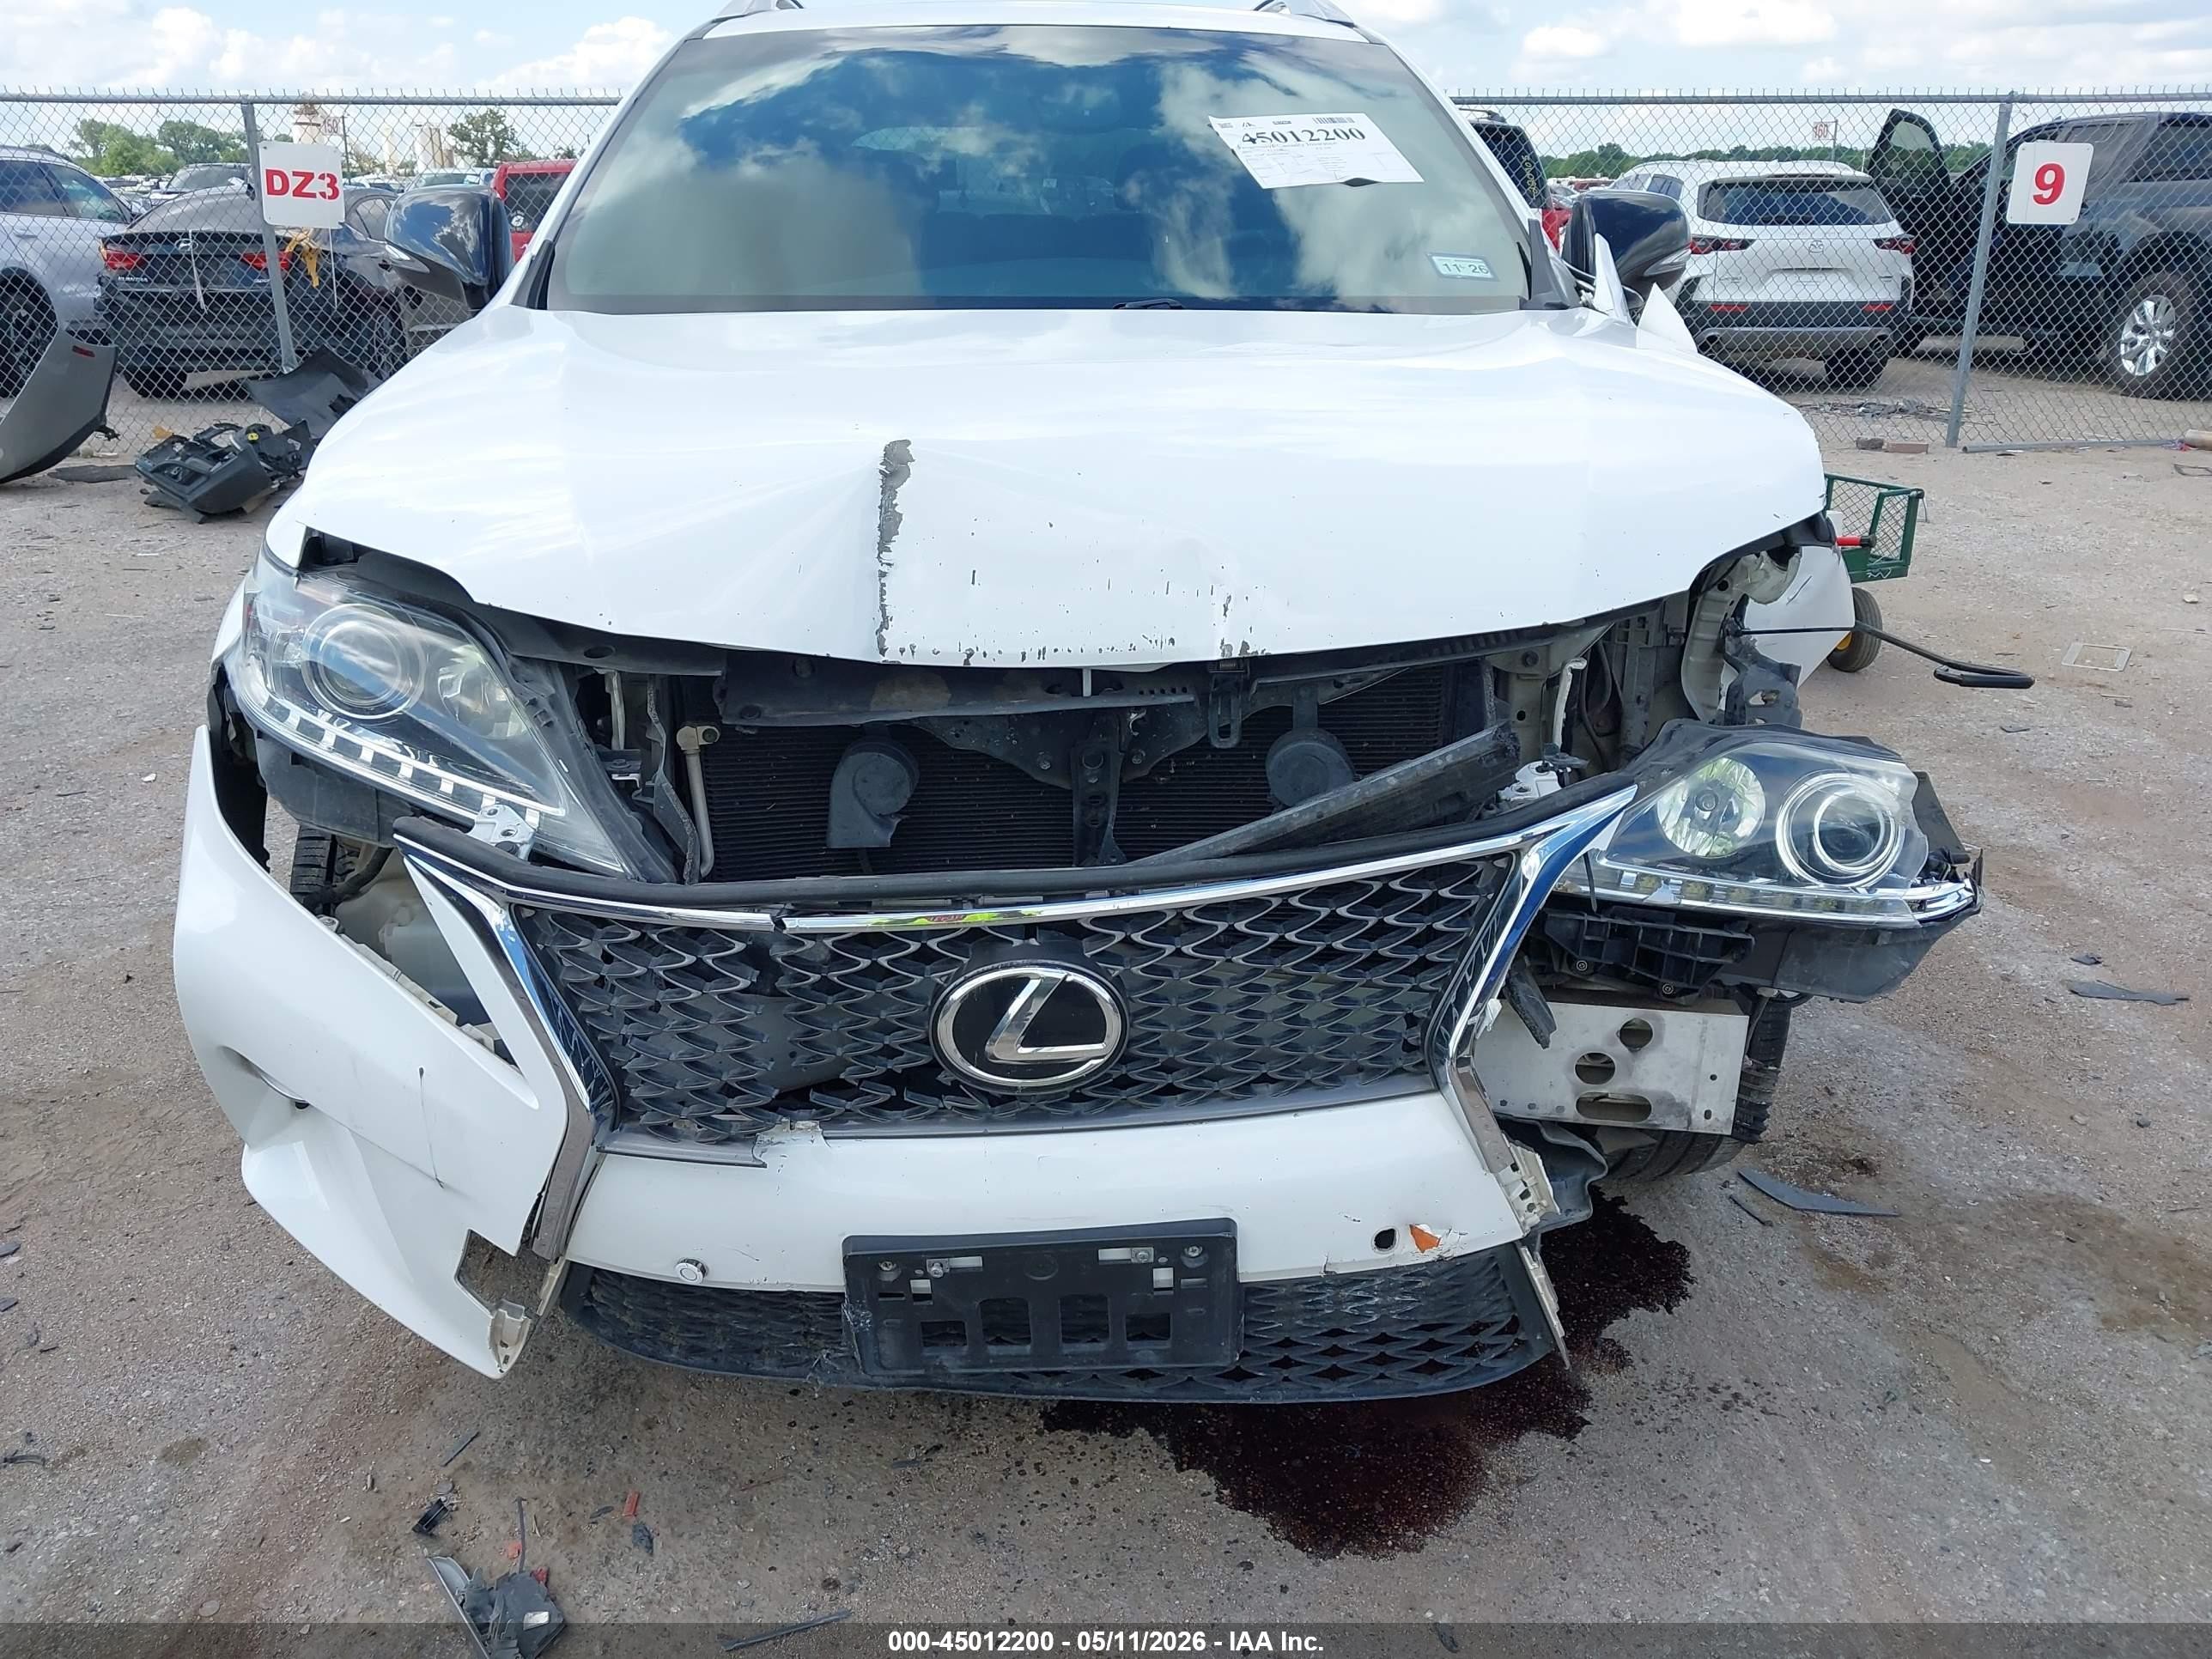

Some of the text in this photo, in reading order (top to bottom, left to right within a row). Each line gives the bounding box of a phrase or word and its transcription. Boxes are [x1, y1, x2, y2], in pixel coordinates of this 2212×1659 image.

[323, 118, 338, 134] 150
[1242, 127, 1366, 144] 45012200
[265, 168, 340, 200] DZ3
[2033, 162, 2066, 204] 9
